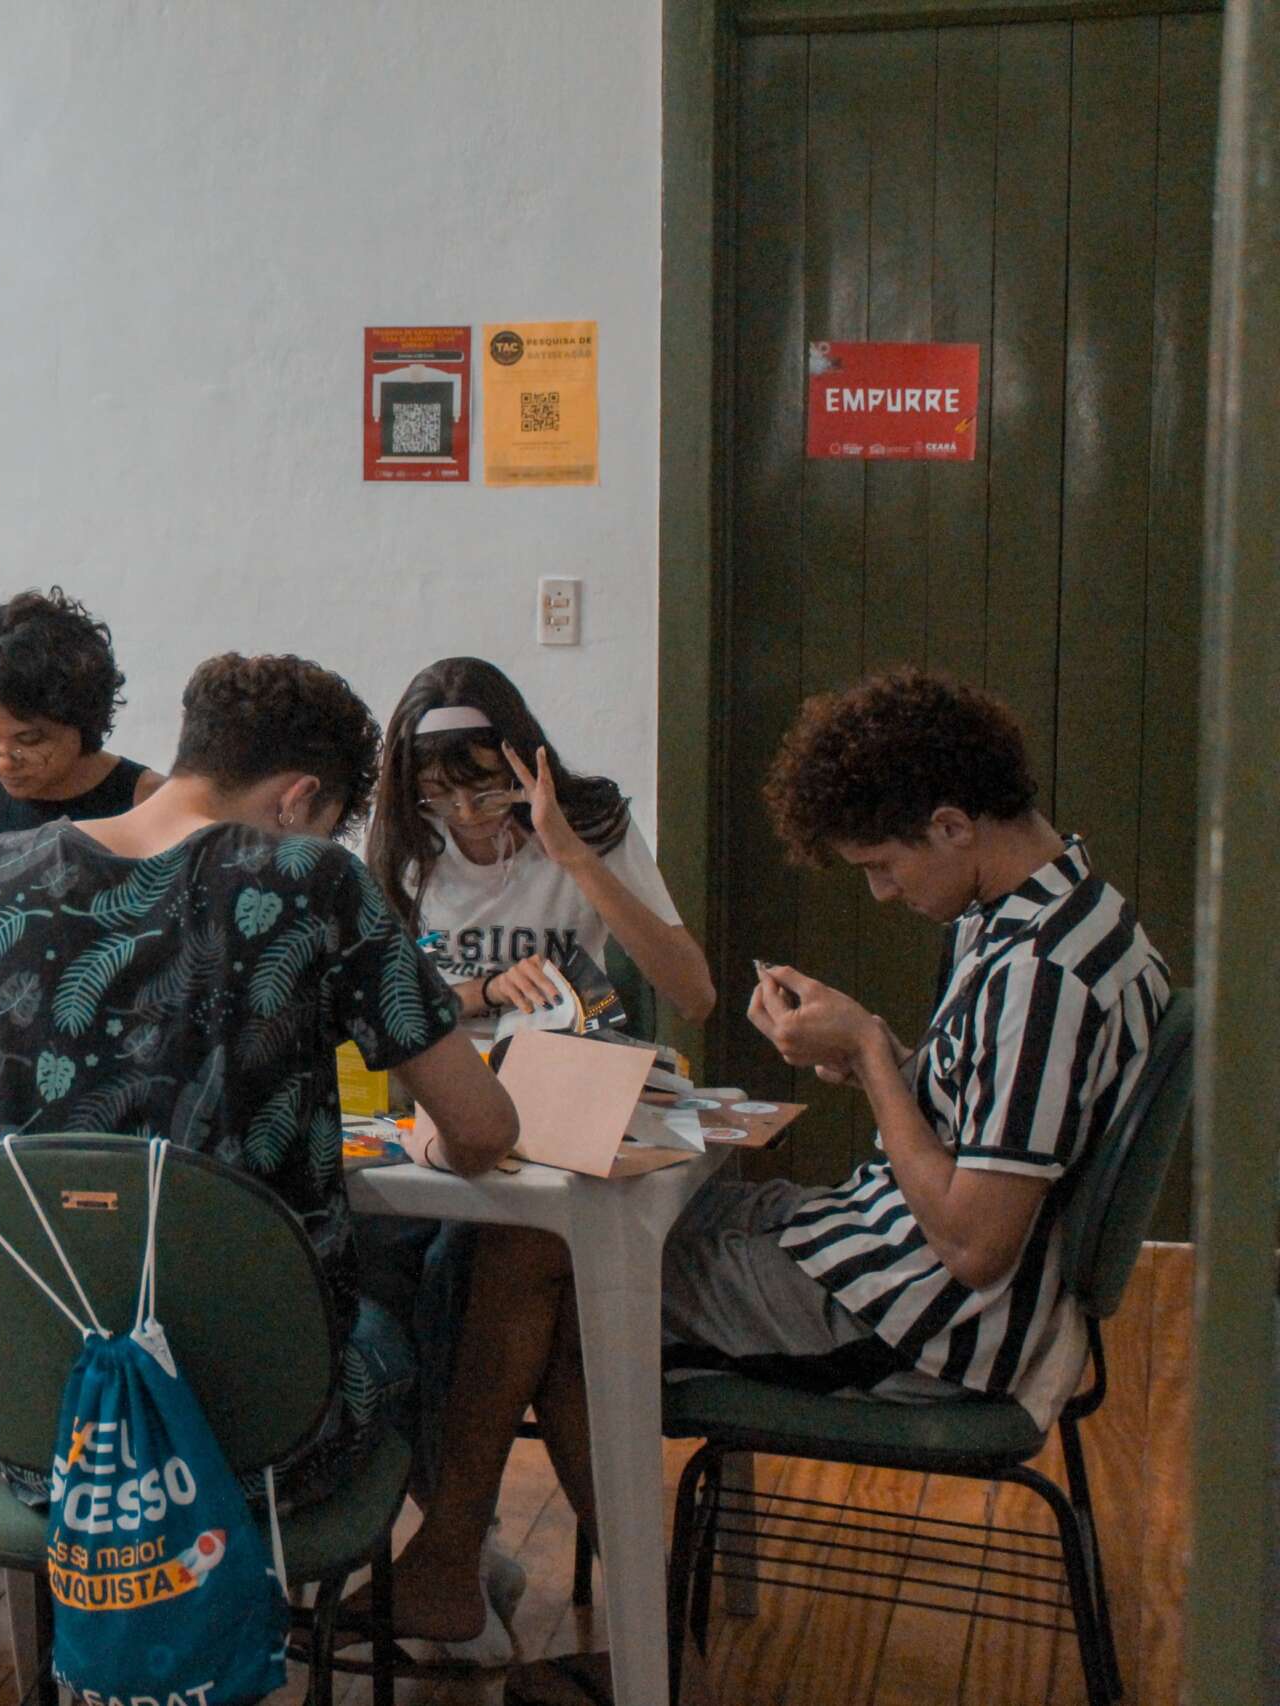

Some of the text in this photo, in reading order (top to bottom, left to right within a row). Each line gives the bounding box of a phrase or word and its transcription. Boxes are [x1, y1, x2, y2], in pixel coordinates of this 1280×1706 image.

[495, 341, 519, 353] TAC
[526, 336, 592, 346] PESQUISA DE
[825, 387, 960, 413] EMPURRE
[435, 925, 577, 966] ESIGN
[96, 1535, 166, 1569] maior
